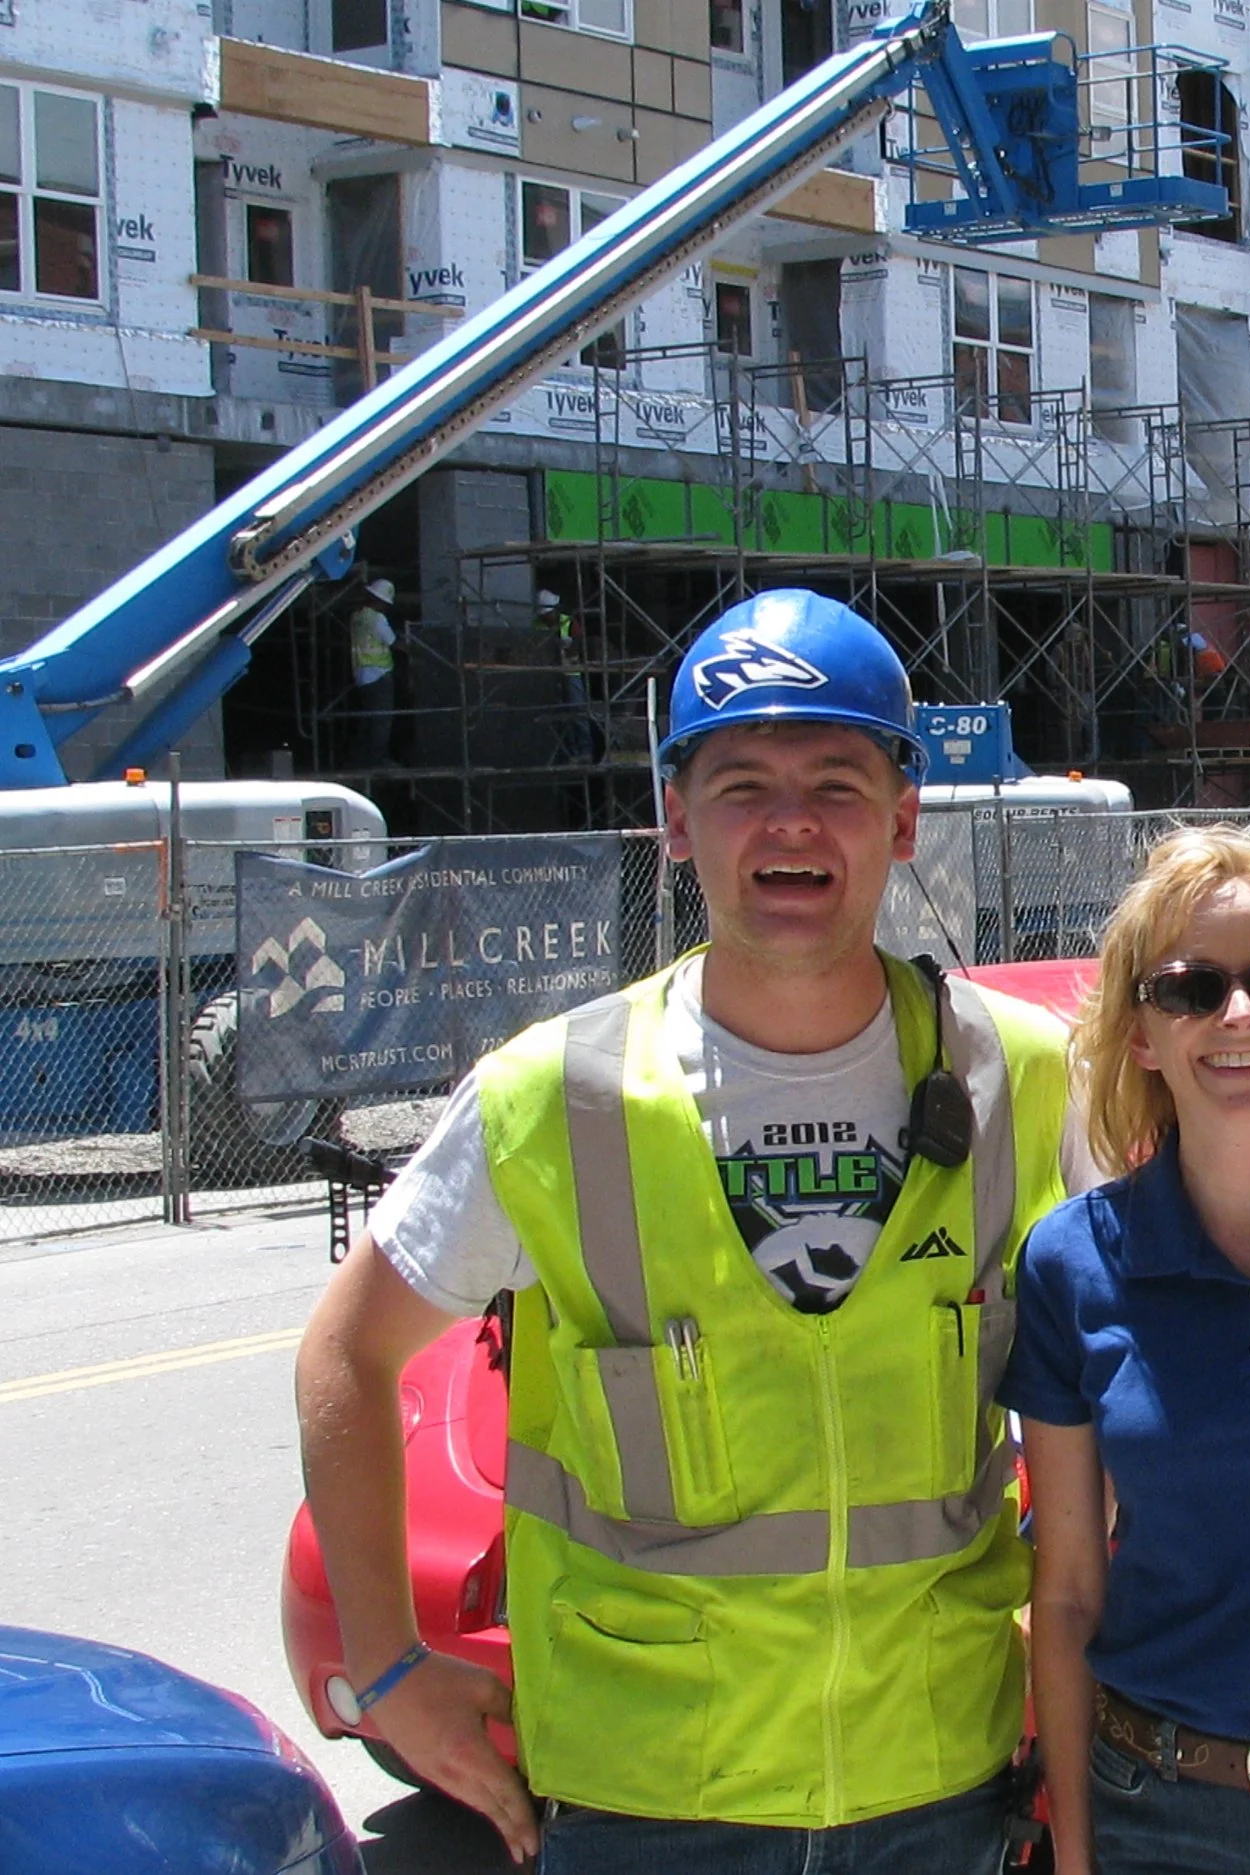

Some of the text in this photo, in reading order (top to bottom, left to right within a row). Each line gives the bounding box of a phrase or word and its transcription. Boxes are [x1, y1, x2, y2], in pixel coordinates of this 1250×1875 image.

[219, 154, 282, 191] Tyvek
[884, 384, 927, 409] Tyvek
[635, 401, 686, 426] Tyvek
[310, 880, 353, 899] MILL
[360, 876, 404, 898] CREEK
[409, 869, 498, 891] ESIDENTIAL
[501, 864, 592, 885] COMMUNITY
[360, 988, 421, 1011] PEOPLE
[440, 979, 493, 1001] PLACES
[320, 1042, 454, 1073] MCRTRUST.COM
[763, 1121, 857, 1147] 2012
